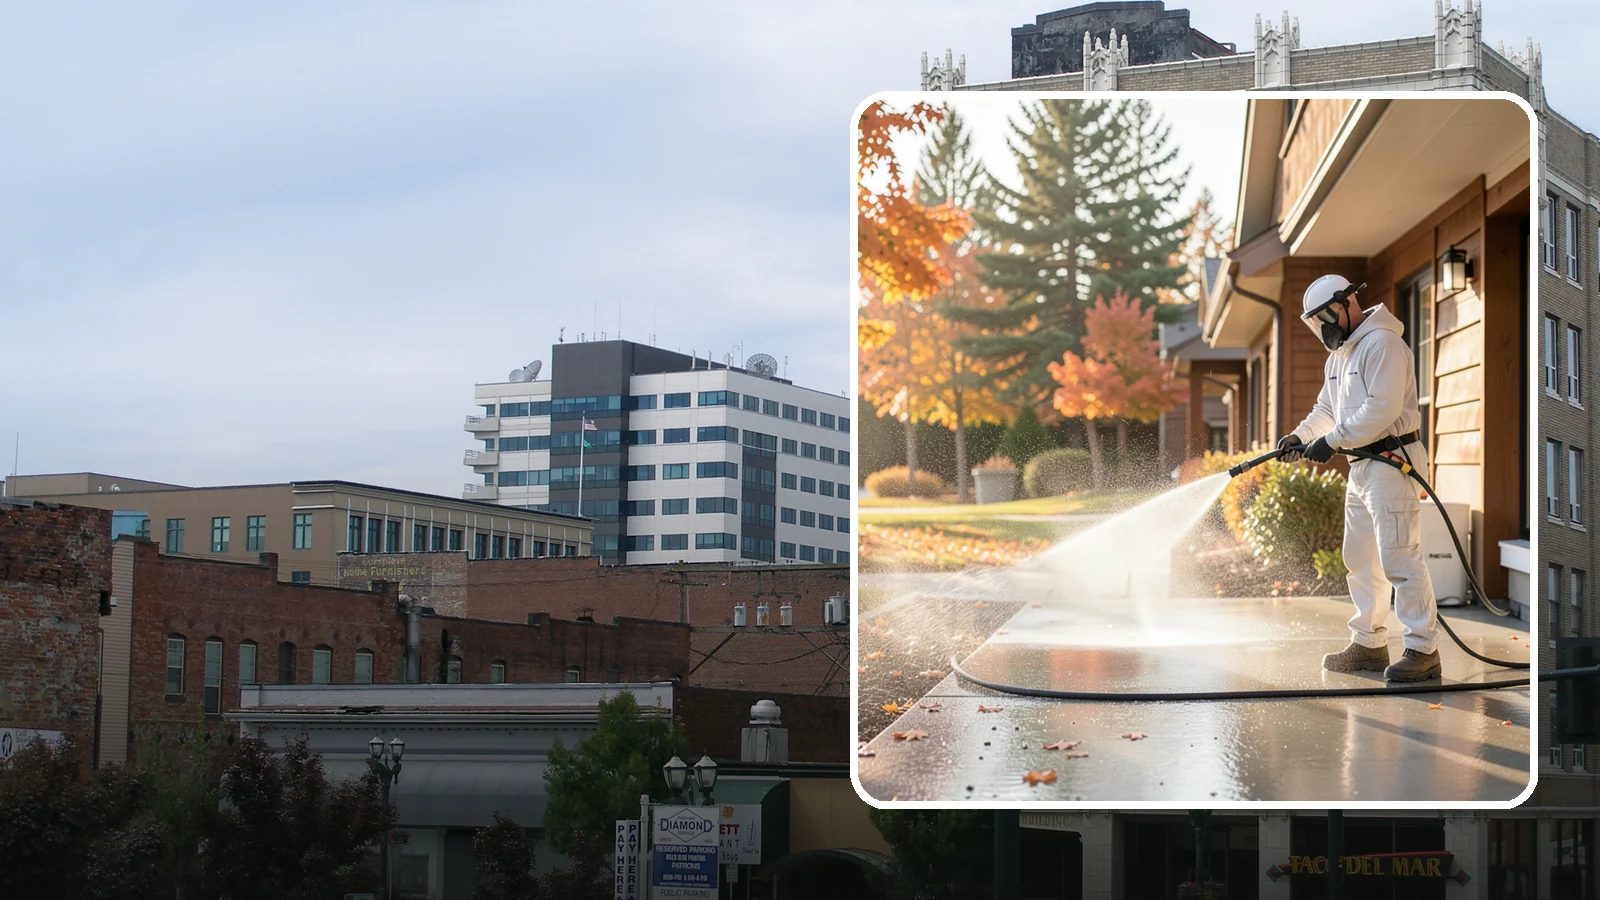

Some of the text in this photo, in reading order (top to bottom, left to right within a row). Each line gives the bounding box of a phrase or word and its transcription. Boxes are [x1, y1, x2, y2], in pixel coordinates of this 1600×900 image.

[370, 565, 427, 576] Furnishers
[660, 818, 713, 832] DIAMOND
[1022, 815, 1069, 828] BUILDING
[656, 845, 716, 854] RESERVED PARKING
[616, 825, 625, 893] PAY HERE
[627, 825, 637, 893] PAY HERE
[671, 862, 701, 870] PATRONS
[1346, 856, 1384, 876] DEL
[1391, 857, 1442, 876] MAR
[660, 889, 710, 898] PUBLIC PARKING
